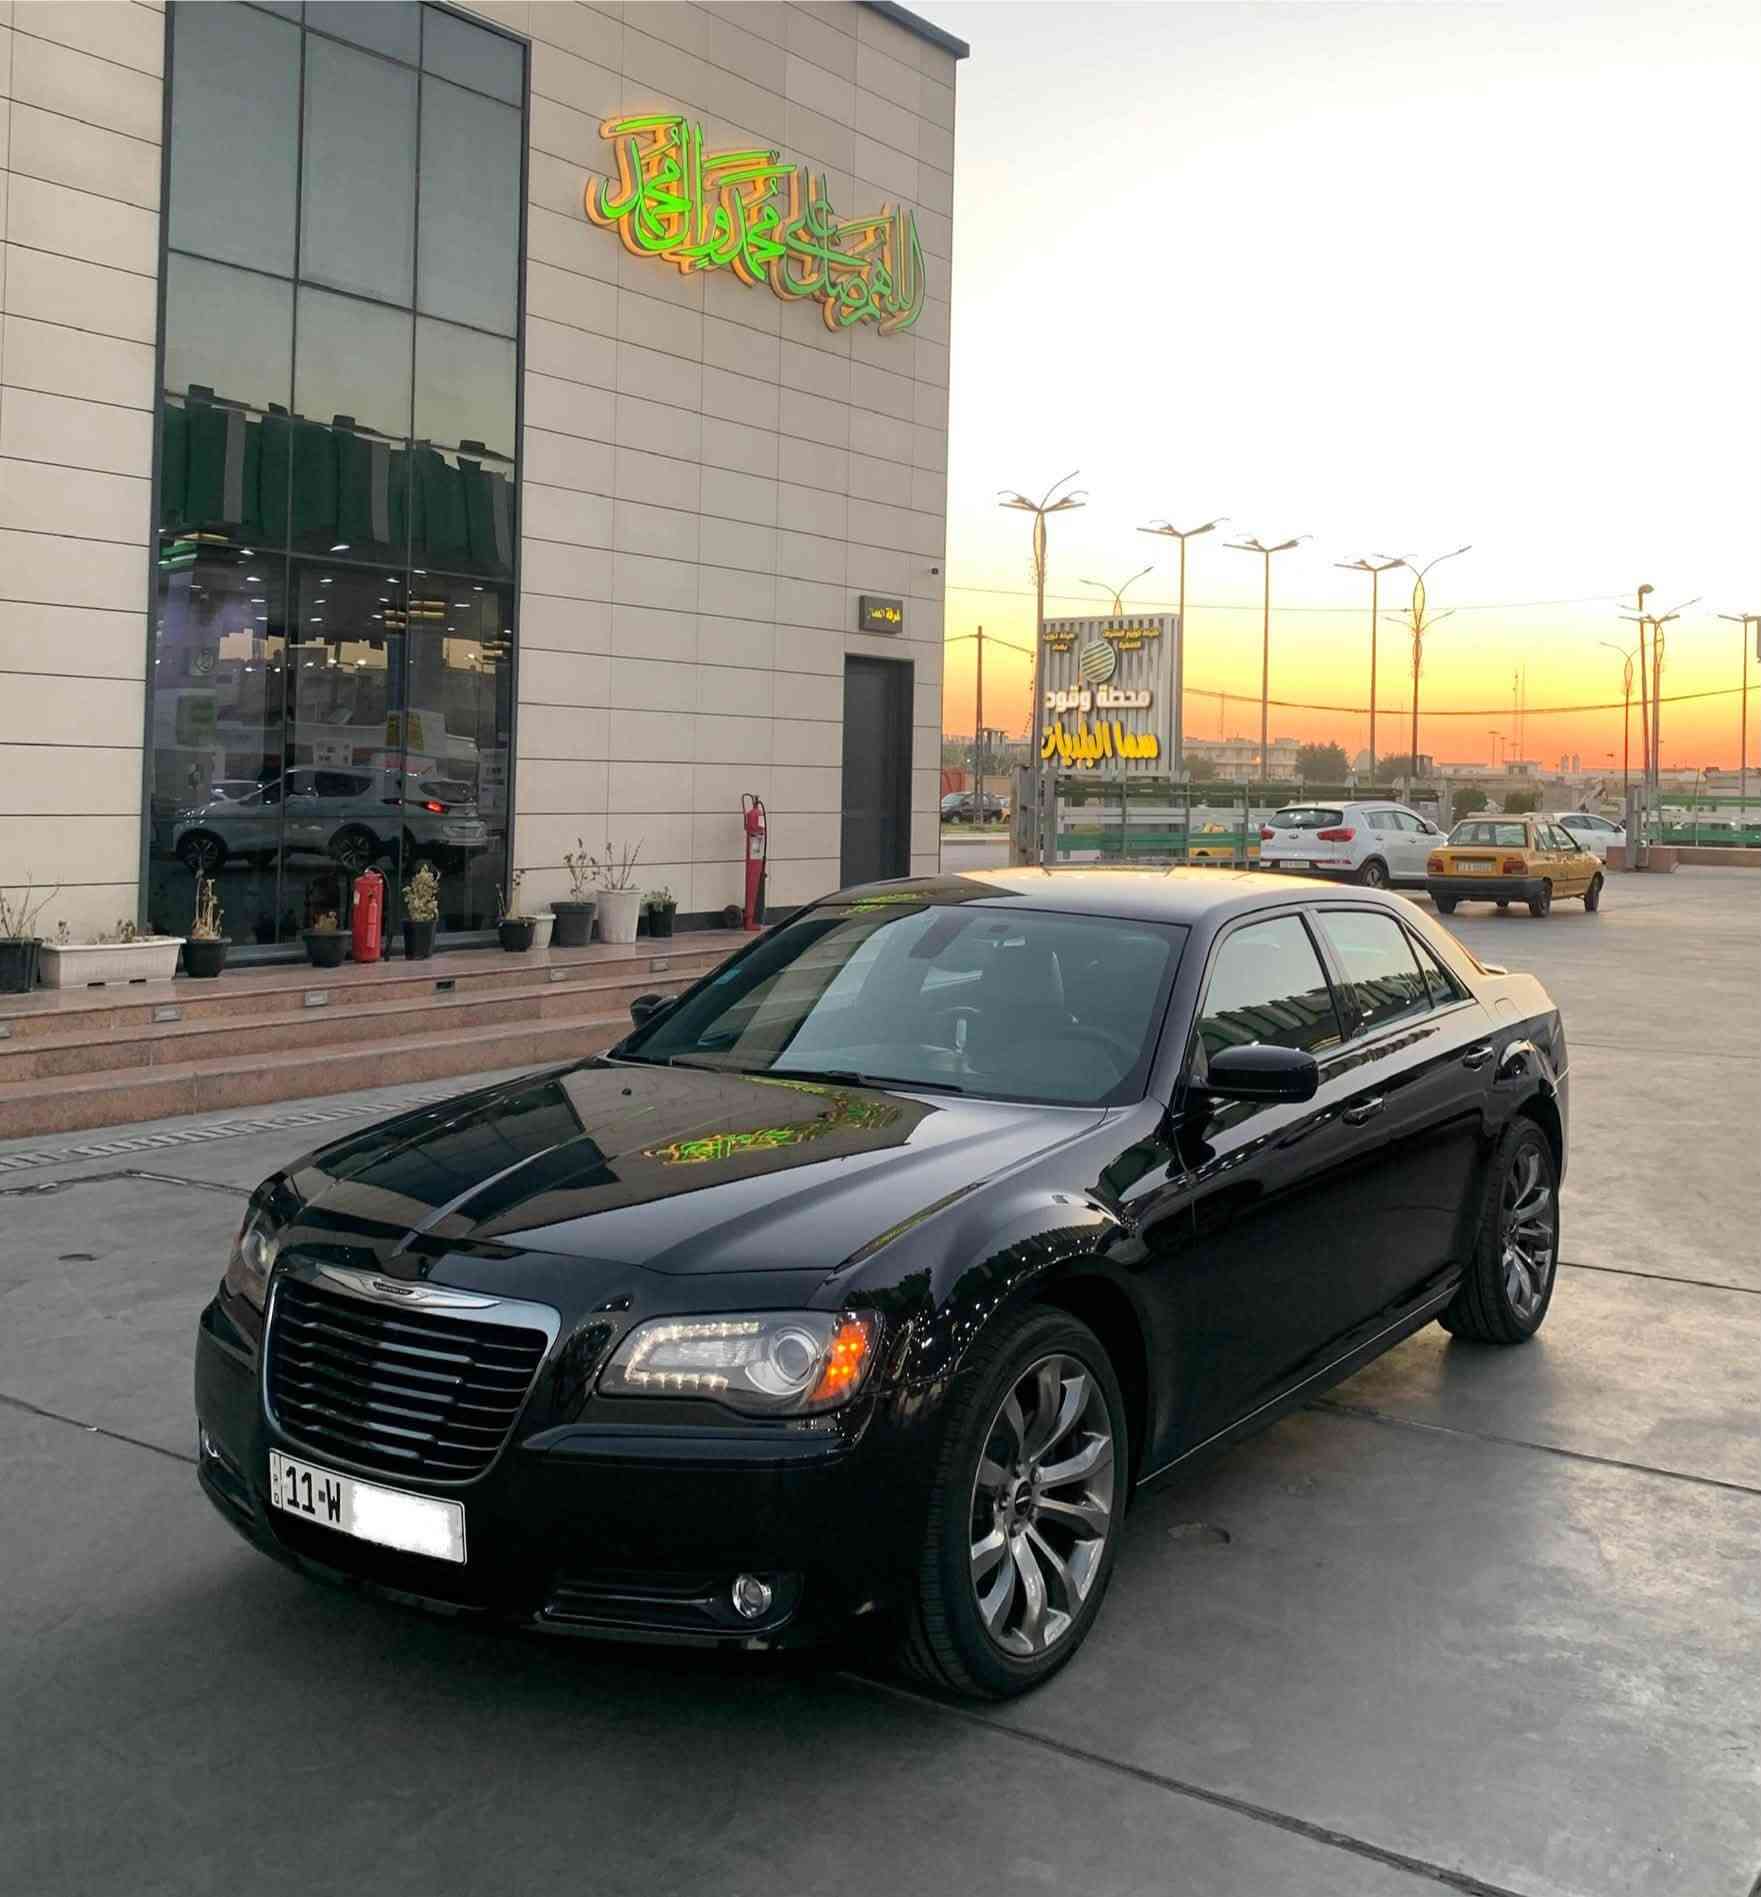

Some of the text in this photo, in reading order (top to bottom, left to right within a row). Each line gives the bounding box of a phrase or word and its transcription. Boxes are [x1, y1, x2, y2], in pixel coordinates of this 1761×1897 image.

[1044, 684, 1152, 713] محطة وقود
[1113, 720, 1159, 759] سما
[286, 1465, 341, 1523] 11-W
